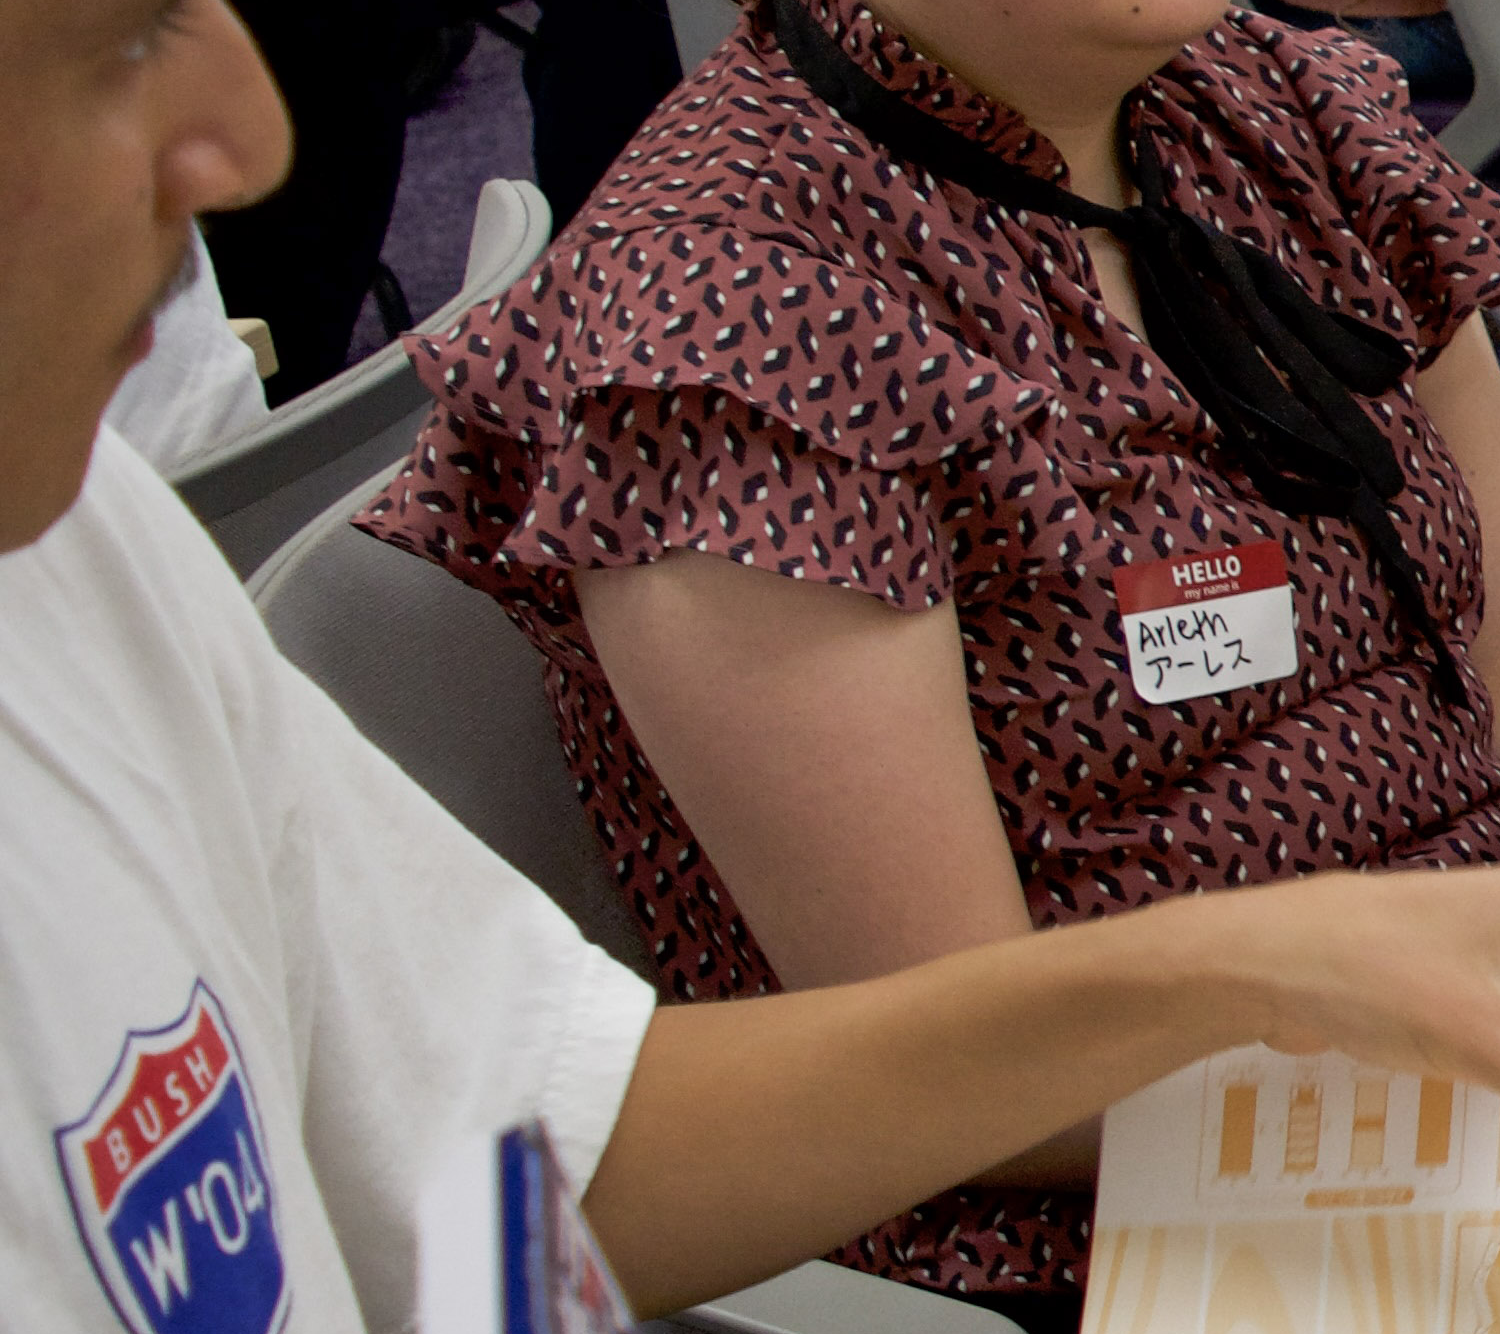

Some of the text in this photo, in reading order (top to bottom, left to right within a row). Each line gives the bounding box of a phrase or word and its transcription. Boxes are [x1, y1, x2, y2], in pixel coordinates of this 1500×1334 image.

[1171, 554, 1242, 587] HELLO
[1183, 580, 1241, 600] my name is
[1145, 638, 1252, 689] アーレス
[103, 1045, 217, 1175] BUSH
